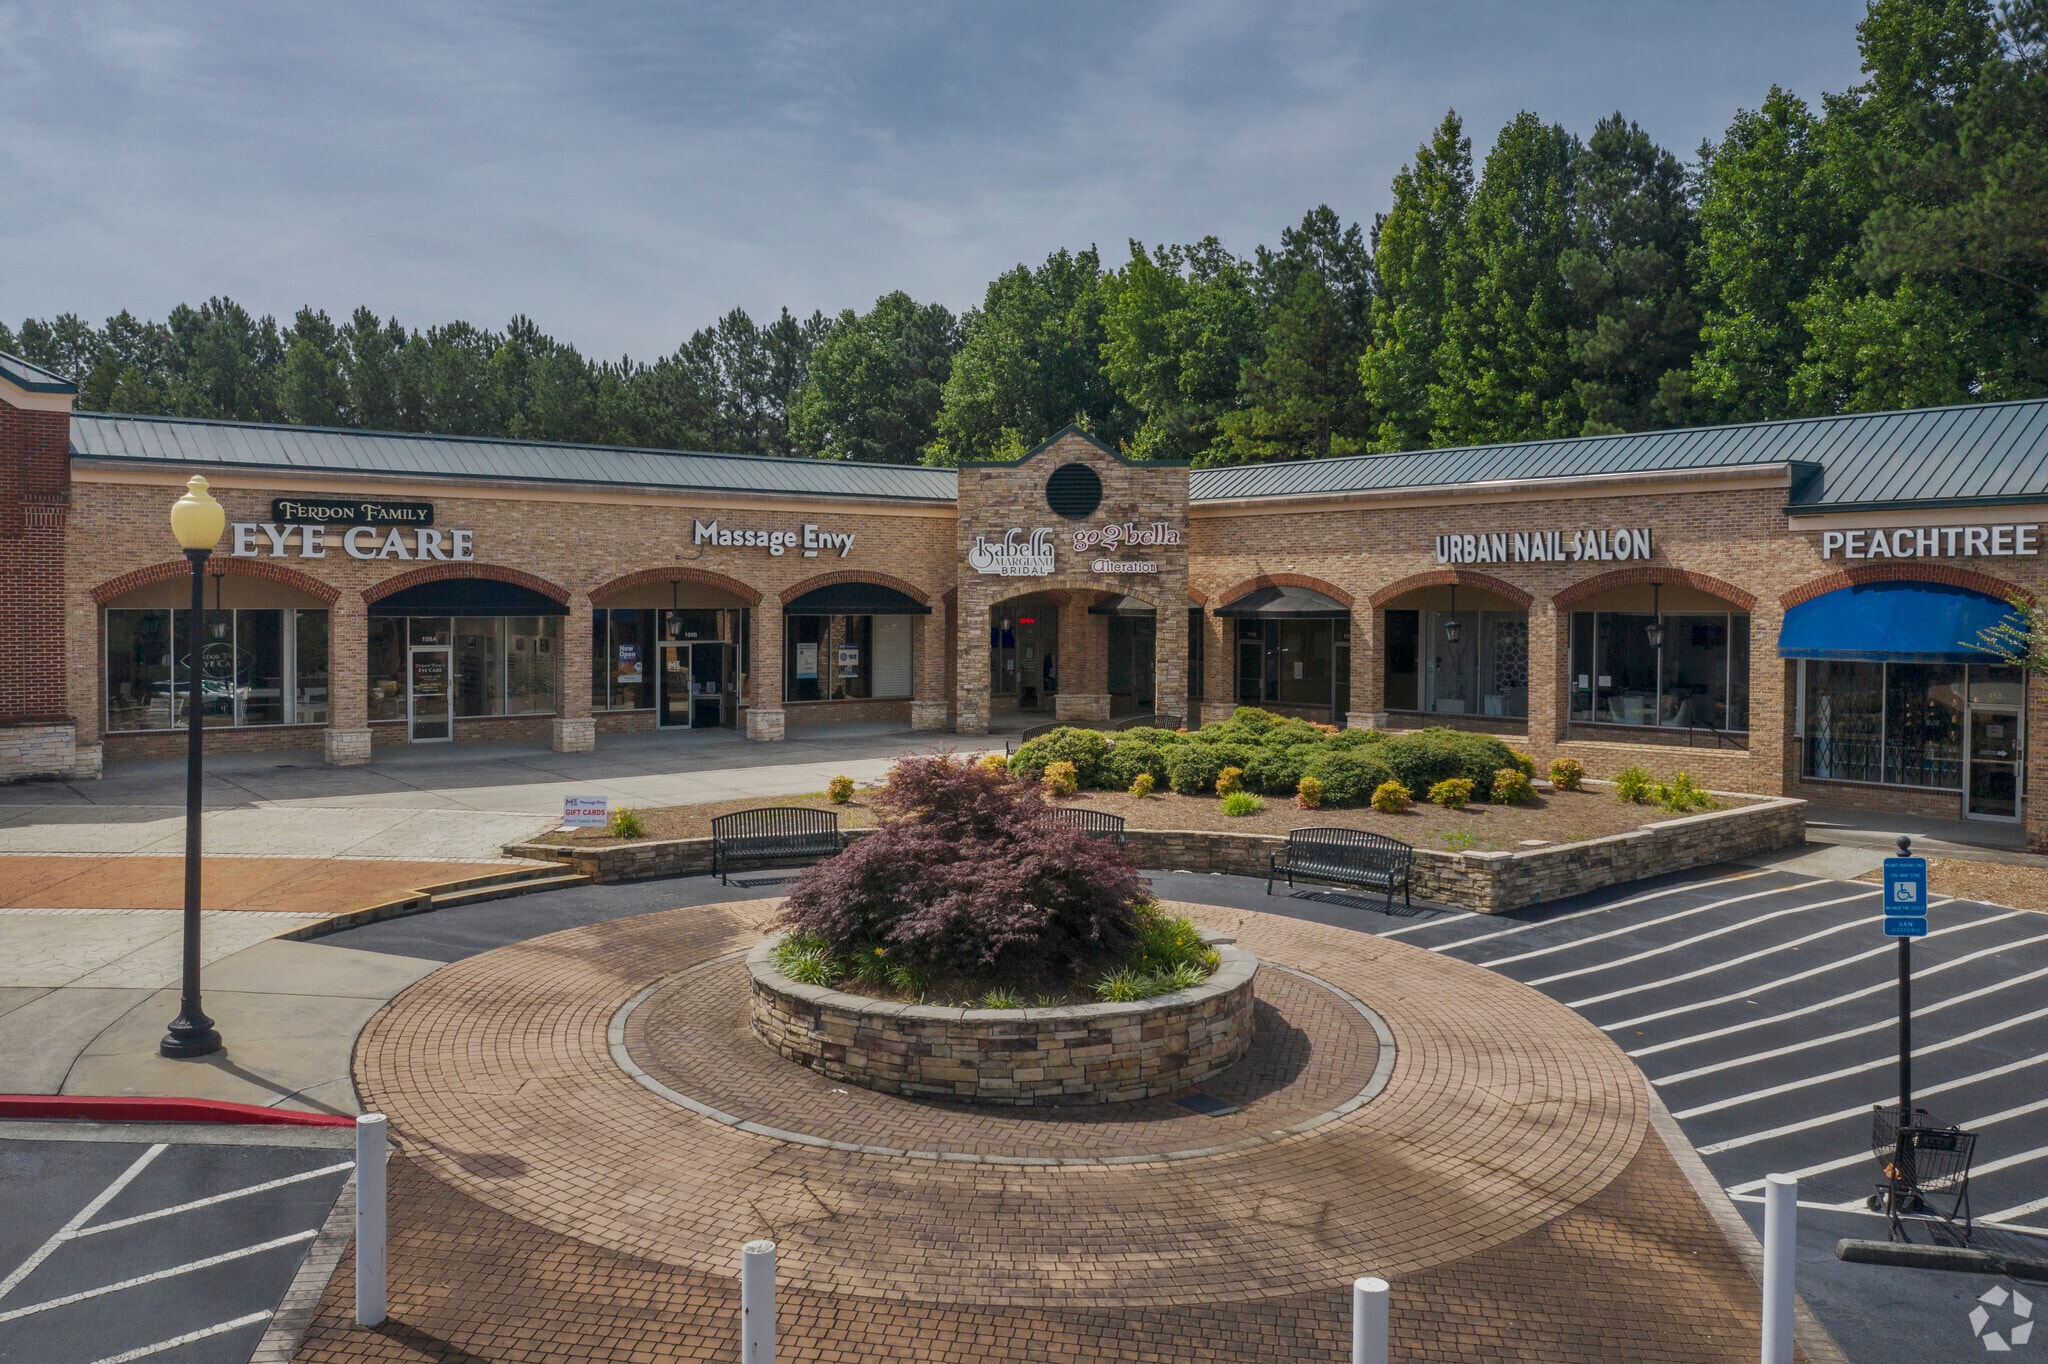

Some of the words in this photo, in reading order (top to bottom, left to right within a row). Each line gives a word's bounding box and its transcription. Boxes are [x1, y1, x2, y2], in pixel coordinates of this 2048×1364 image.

[279, 501, 355, 521] FERDON
[360, 503, 429, 521] FAMILY
[231, 522, 326, 558] EYE
[342, 526, 474, 561] CARE
[693, 519, 796, 556] Massage
[803, 524, 856, 557] Envy
[970, 528, 1054, 568] Isabella
[1436, 533, 1509, 564] URBAN
[1514, 531, 1567, 562] NAIL
[1573, 528, 1652, 561] SALON
[1822, 524, 2039, 559] PEACHTREE
[1001, 566, 1047, 575] BRIDAL
[619, 651, 636, 659] Open
